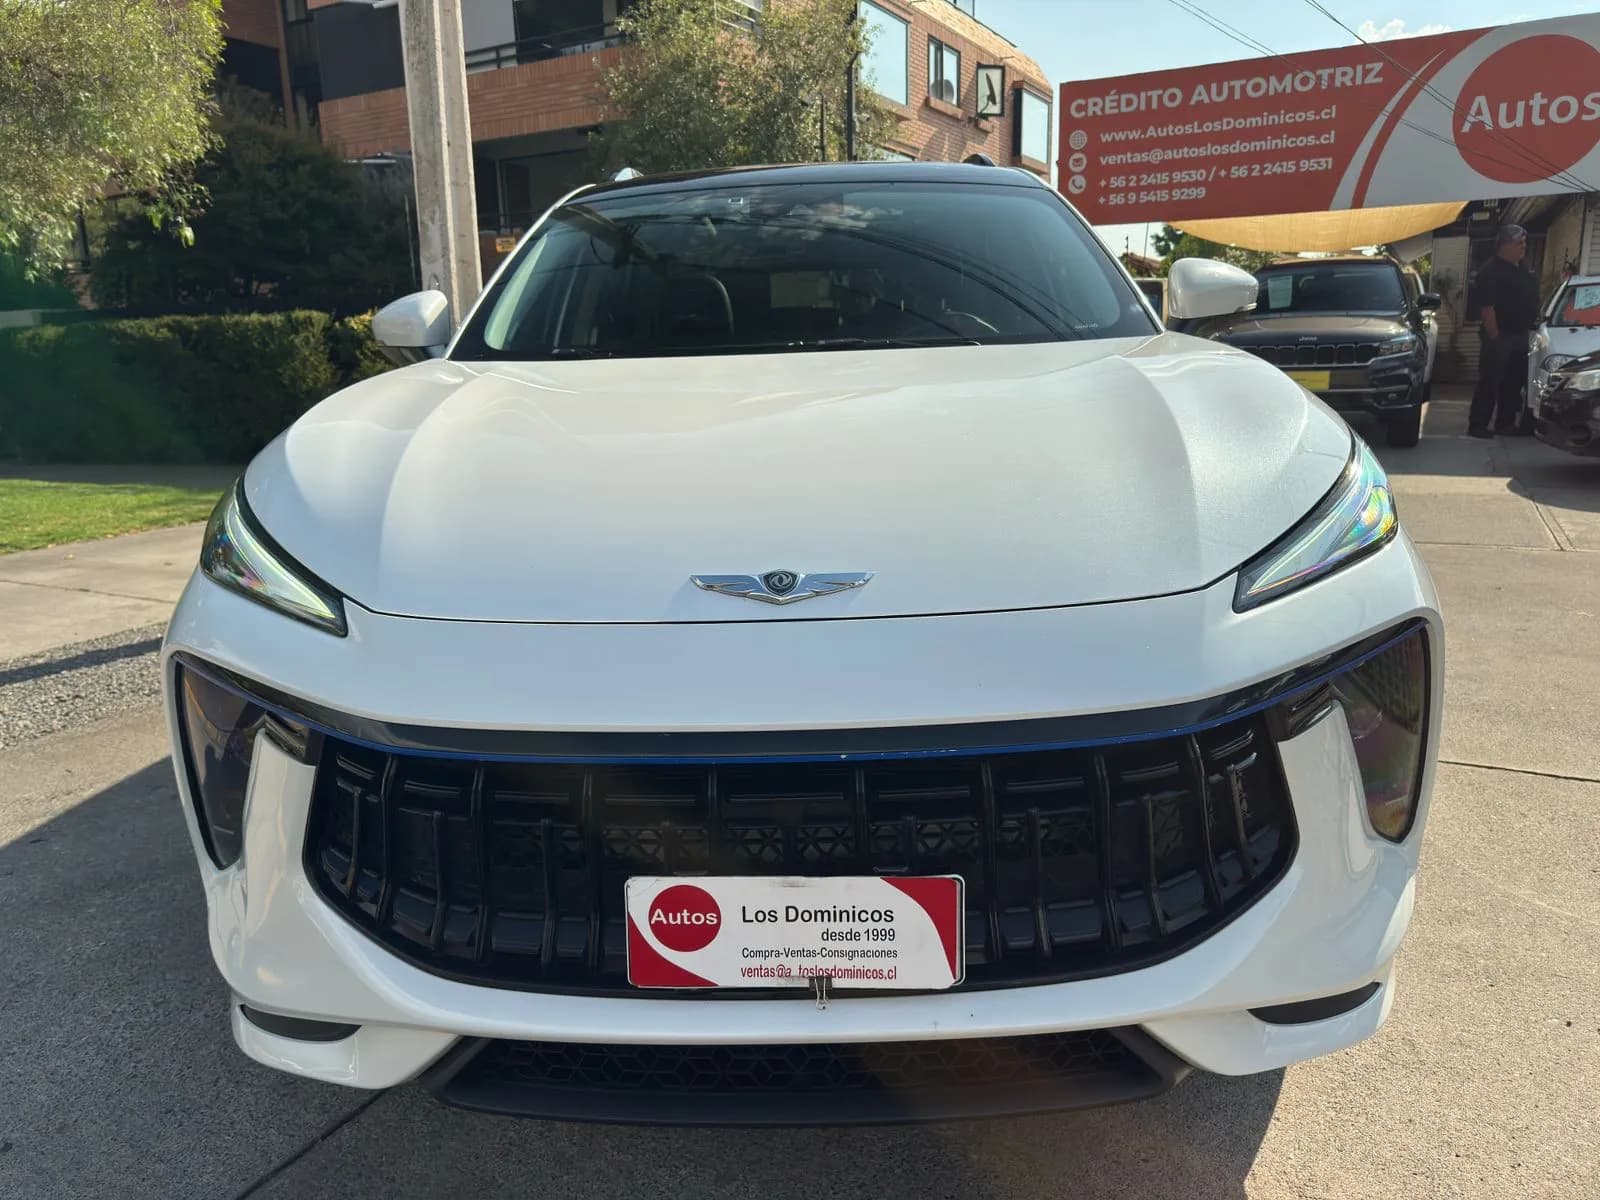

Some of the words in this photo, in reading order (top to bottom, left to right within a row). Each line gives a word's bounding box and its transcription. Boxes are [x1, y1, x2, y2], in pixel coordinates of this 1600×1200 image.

[1070, 89, 1183, 118] CRÉDITO
[1189, 62, 1383, 105] AUTOMOTRIZ
[1461, 91, 1600, 133] Autos
[1100, 104, 1337, 143] www.AutosLosDominicos.cl
[1100, 130, 1336, 166] ventas@autoslosdominicos.cl
[1099, 180, 1107, 188] +
[1109, 176, 1126, 188] 56
[1128, 175, 1137, 187] 2
[1139, 172, 1170, 186] 2415
[1172, 169, 1206, 183] 9530
[1208, 166, 1217, 182] /
[1218, 169, 1227, 178] +
[1230, 166, 1249, 178] 56
[1250, 164, 1261, 177] 2
[1263, 160, 1296, 175] 2415
[1299, 157, 1333, 172] 9531
[1098, 196, 1106, 204] +
[1108, 193, 1125, 205] 56
[1127, 192, 1136, 204] 9
[1139, 190, 1169, 203] 5415
[1171, 187, 1206, 201] 9299
[651, 908, 718, 925] Autos
[742, 905, 778, 923] Los
[785, 905, 895, 923] Dominicos
[821, 928, 861, 942] desde
[864, 928, 896, 942] 1999
[742, 947, 898, 961] Compra-Ventas-Consignaciones
[741, 963, 897, 980] ventas@atoslosdominicos.cl
